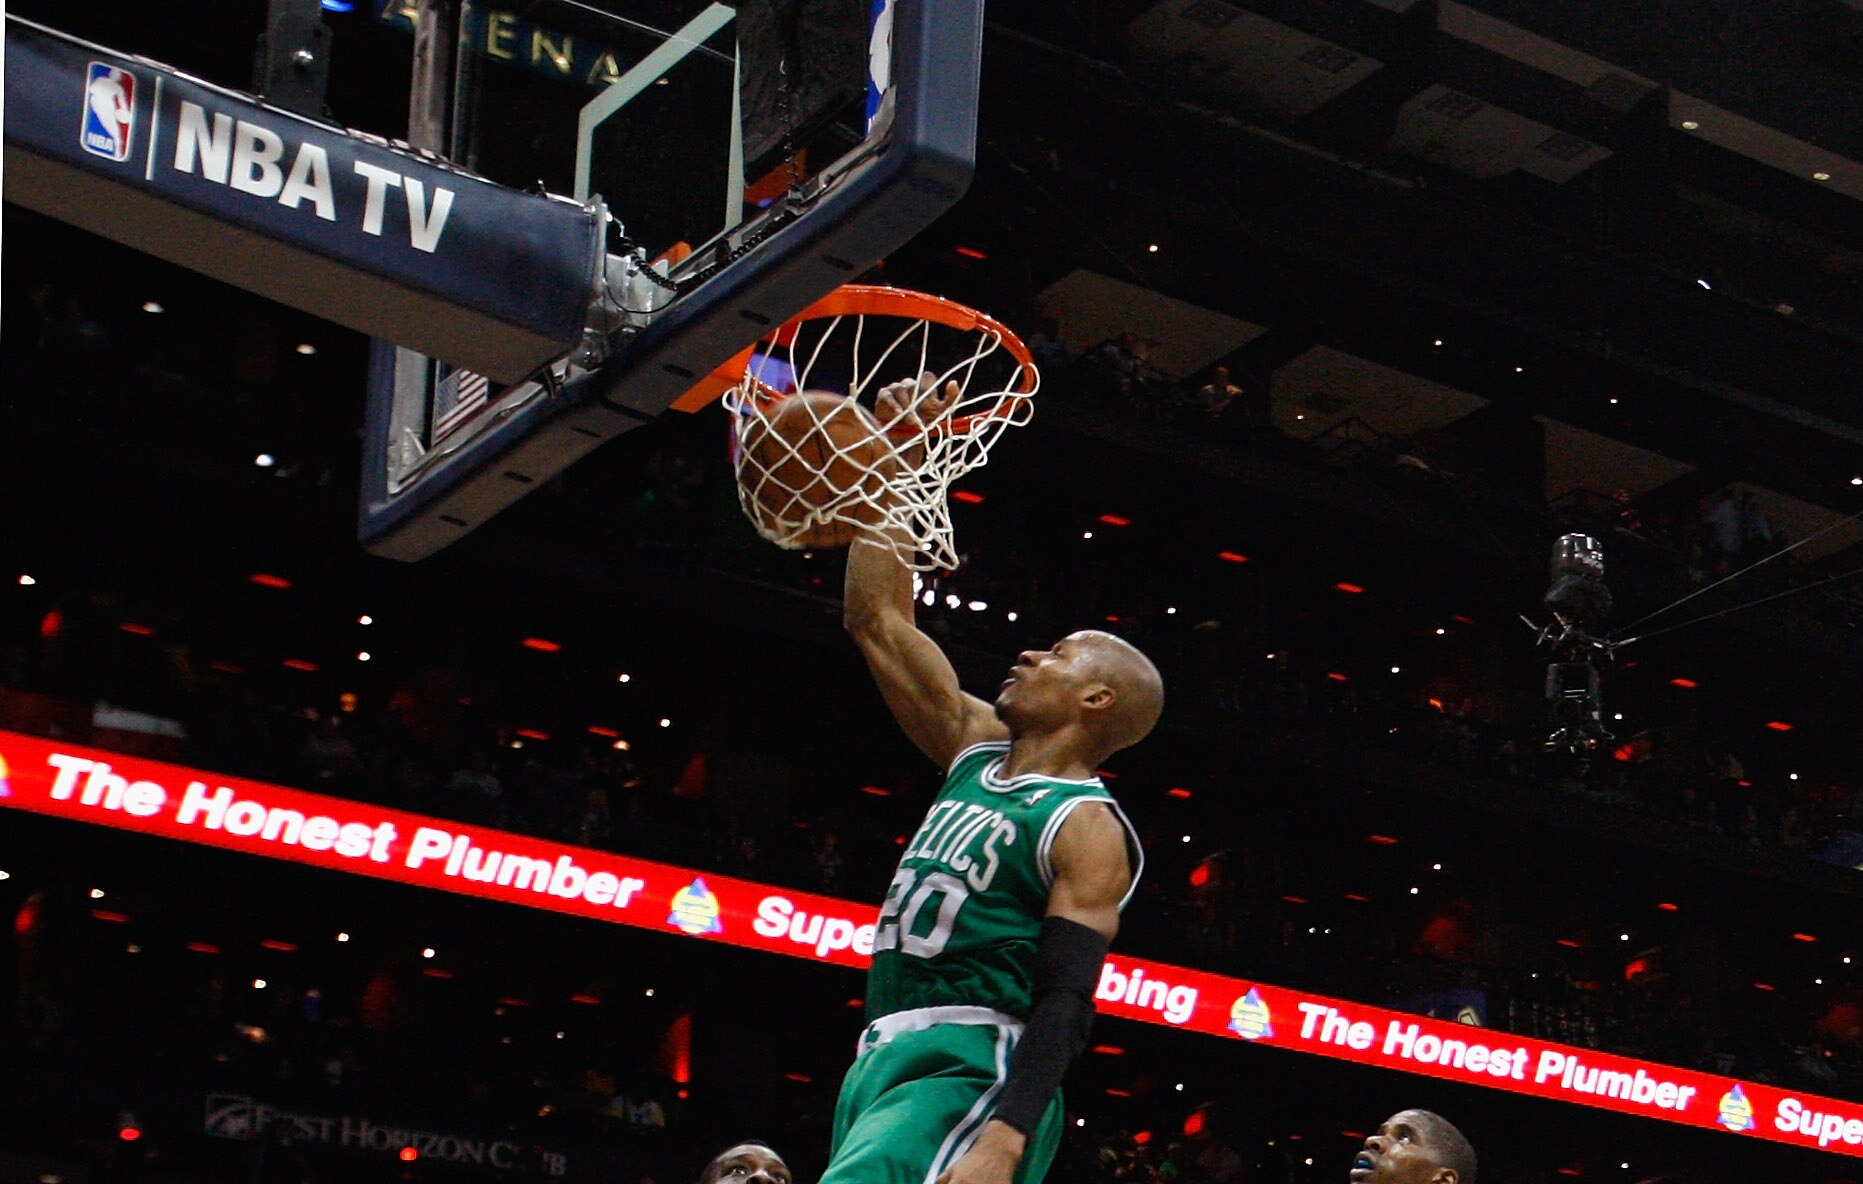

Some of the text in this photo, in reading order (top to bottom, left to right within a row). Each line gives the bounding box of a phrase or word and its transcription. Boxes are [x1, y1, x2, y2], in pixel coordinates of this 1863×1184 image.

[174, 101, 455, 253] NBA TV
[48, 753, 645, 908] The Honest Plumber
[872, 868, 969, 958] 20
[1297, 1002, 1696, 1111] The Honest Plumber
